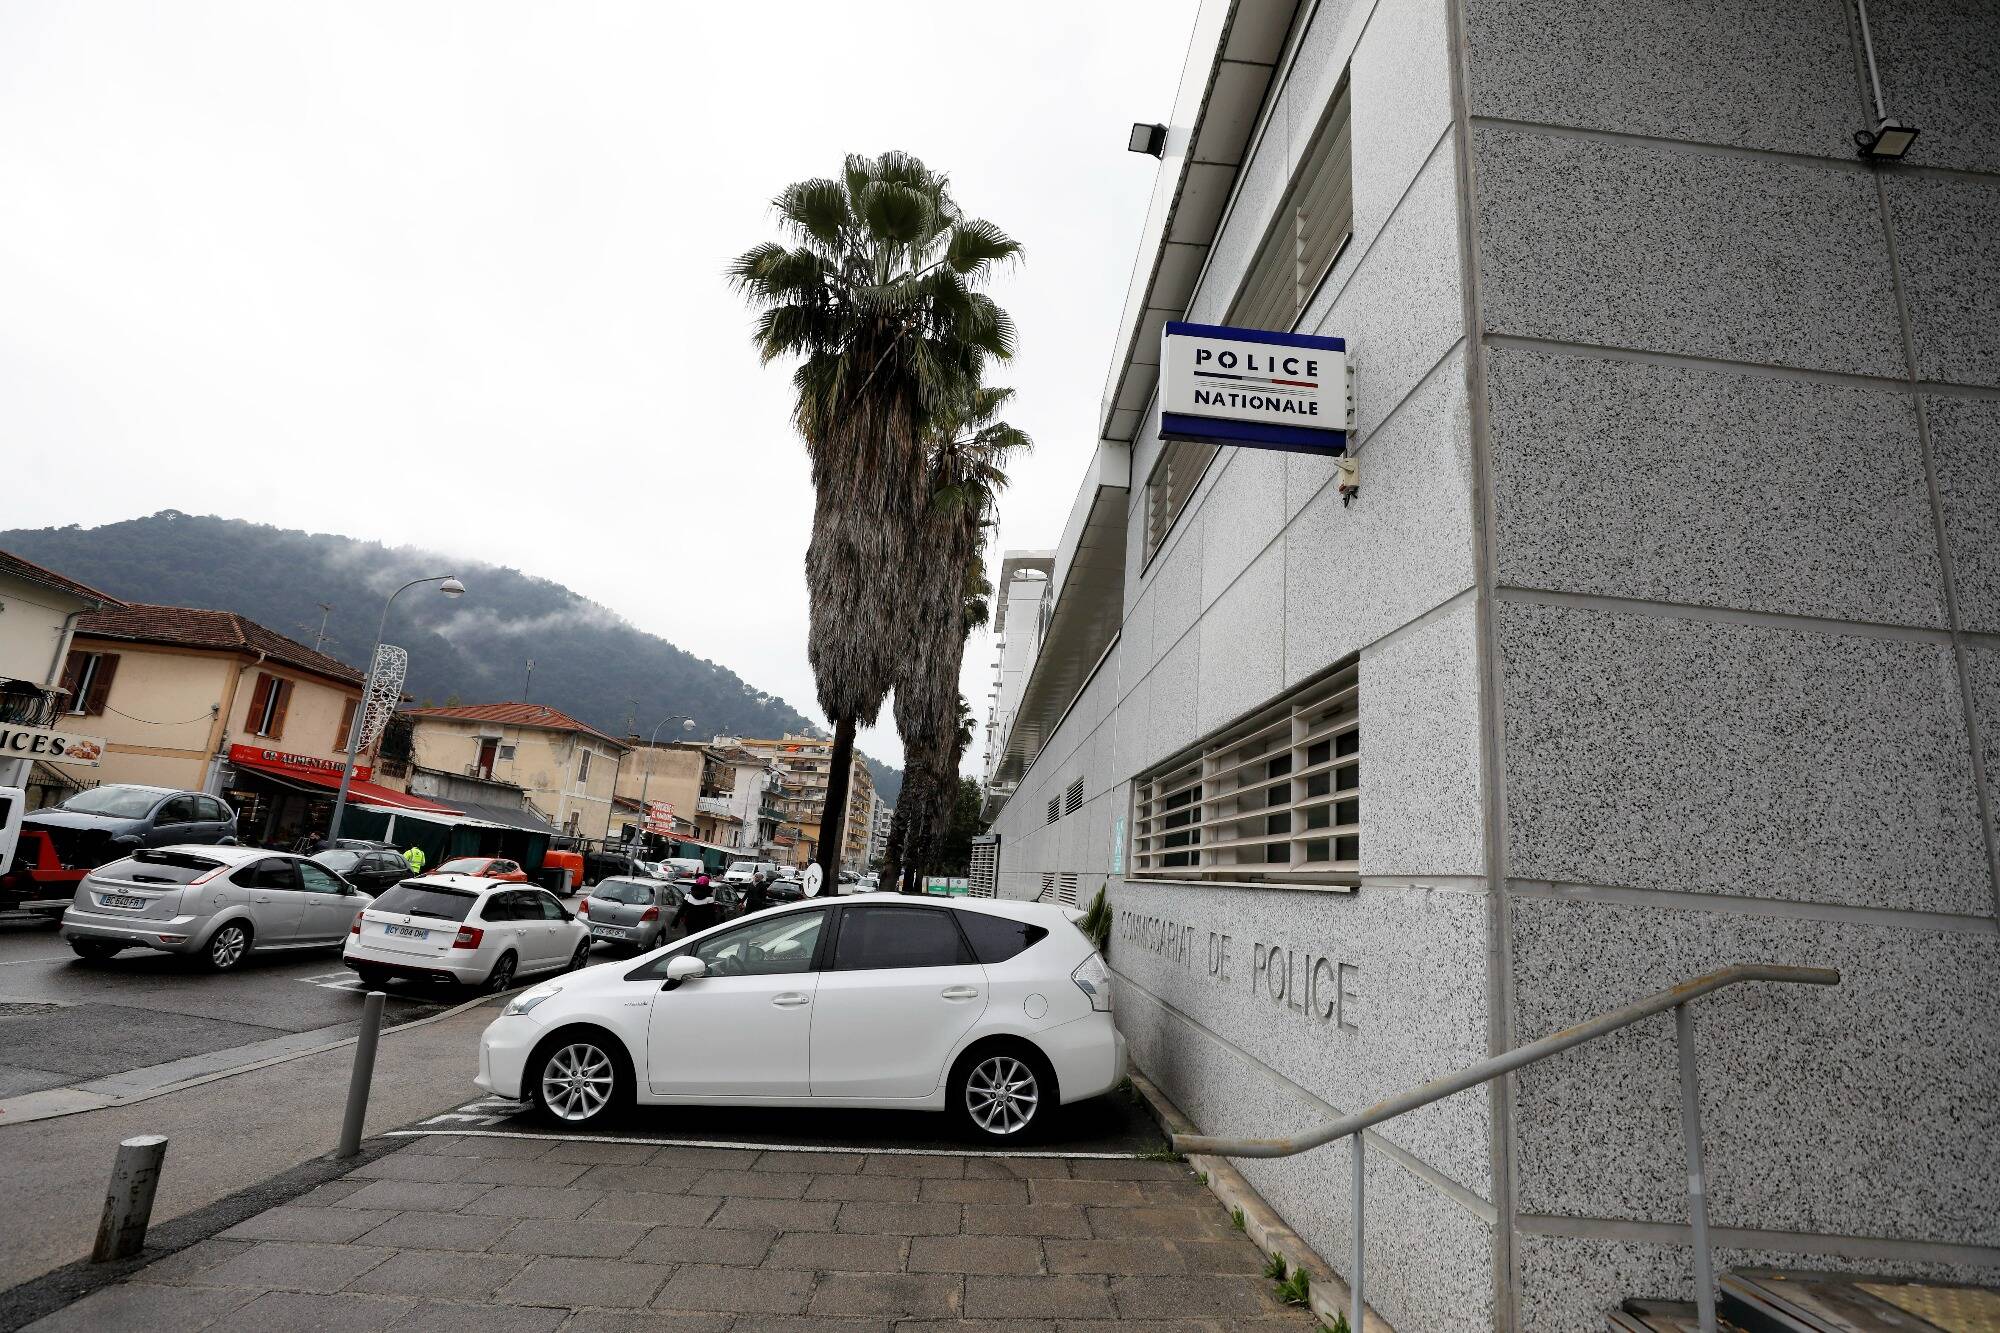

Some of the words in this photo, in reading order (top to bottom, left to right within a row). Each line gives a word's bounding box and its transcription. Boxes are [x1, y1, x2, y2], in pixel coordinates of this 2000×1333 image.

[1196, 348, 1318, 377] POLICE
[1194, 389, 1318, 416] NATIONALE
[281, 753, 346, 771] ALIMENTATIO
[1121, 910, 1195, 970] COMMISSARIAT
[1208, 931, 1232, 982] DE
[1252, 942, 1359, 1036] POLICE
